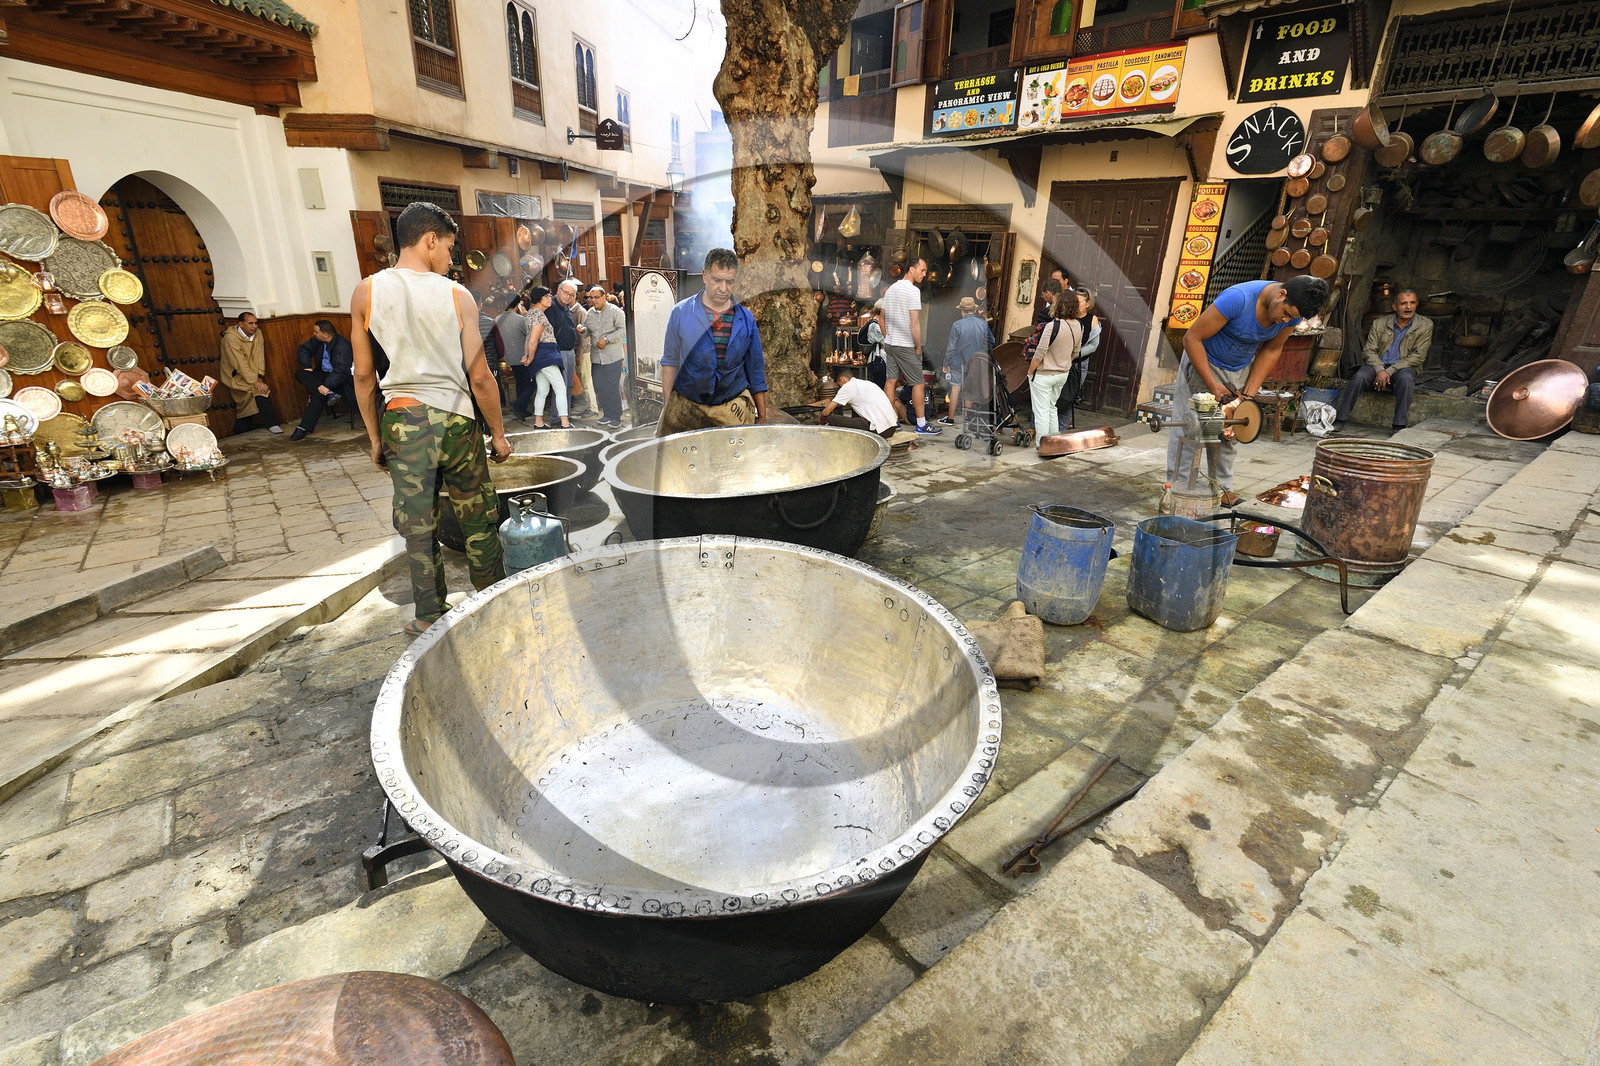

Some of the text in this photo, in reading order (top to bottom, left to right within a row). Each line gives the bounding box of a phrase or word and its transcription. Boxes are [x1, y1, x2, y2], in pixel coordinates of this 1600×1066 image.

[1276, 18, 1336, 40] FOOD
[1124, 55, 1150, 65] COUSCOUS
[1154, 50, 1183, 61] SANDWICHE
[1278, 47, 1321, 64] AND
[1096, 60, 1119, 69] PASTILLA
[954, 75, 996, 91] TERRASSE
[1249, 70, 1335, 93] DRINKS
[938, 91, 1011, 109] PANORAMIC VIEW
[966, 88, 981, 96] AND
[1226, 108, 1302, 166] SNACK
